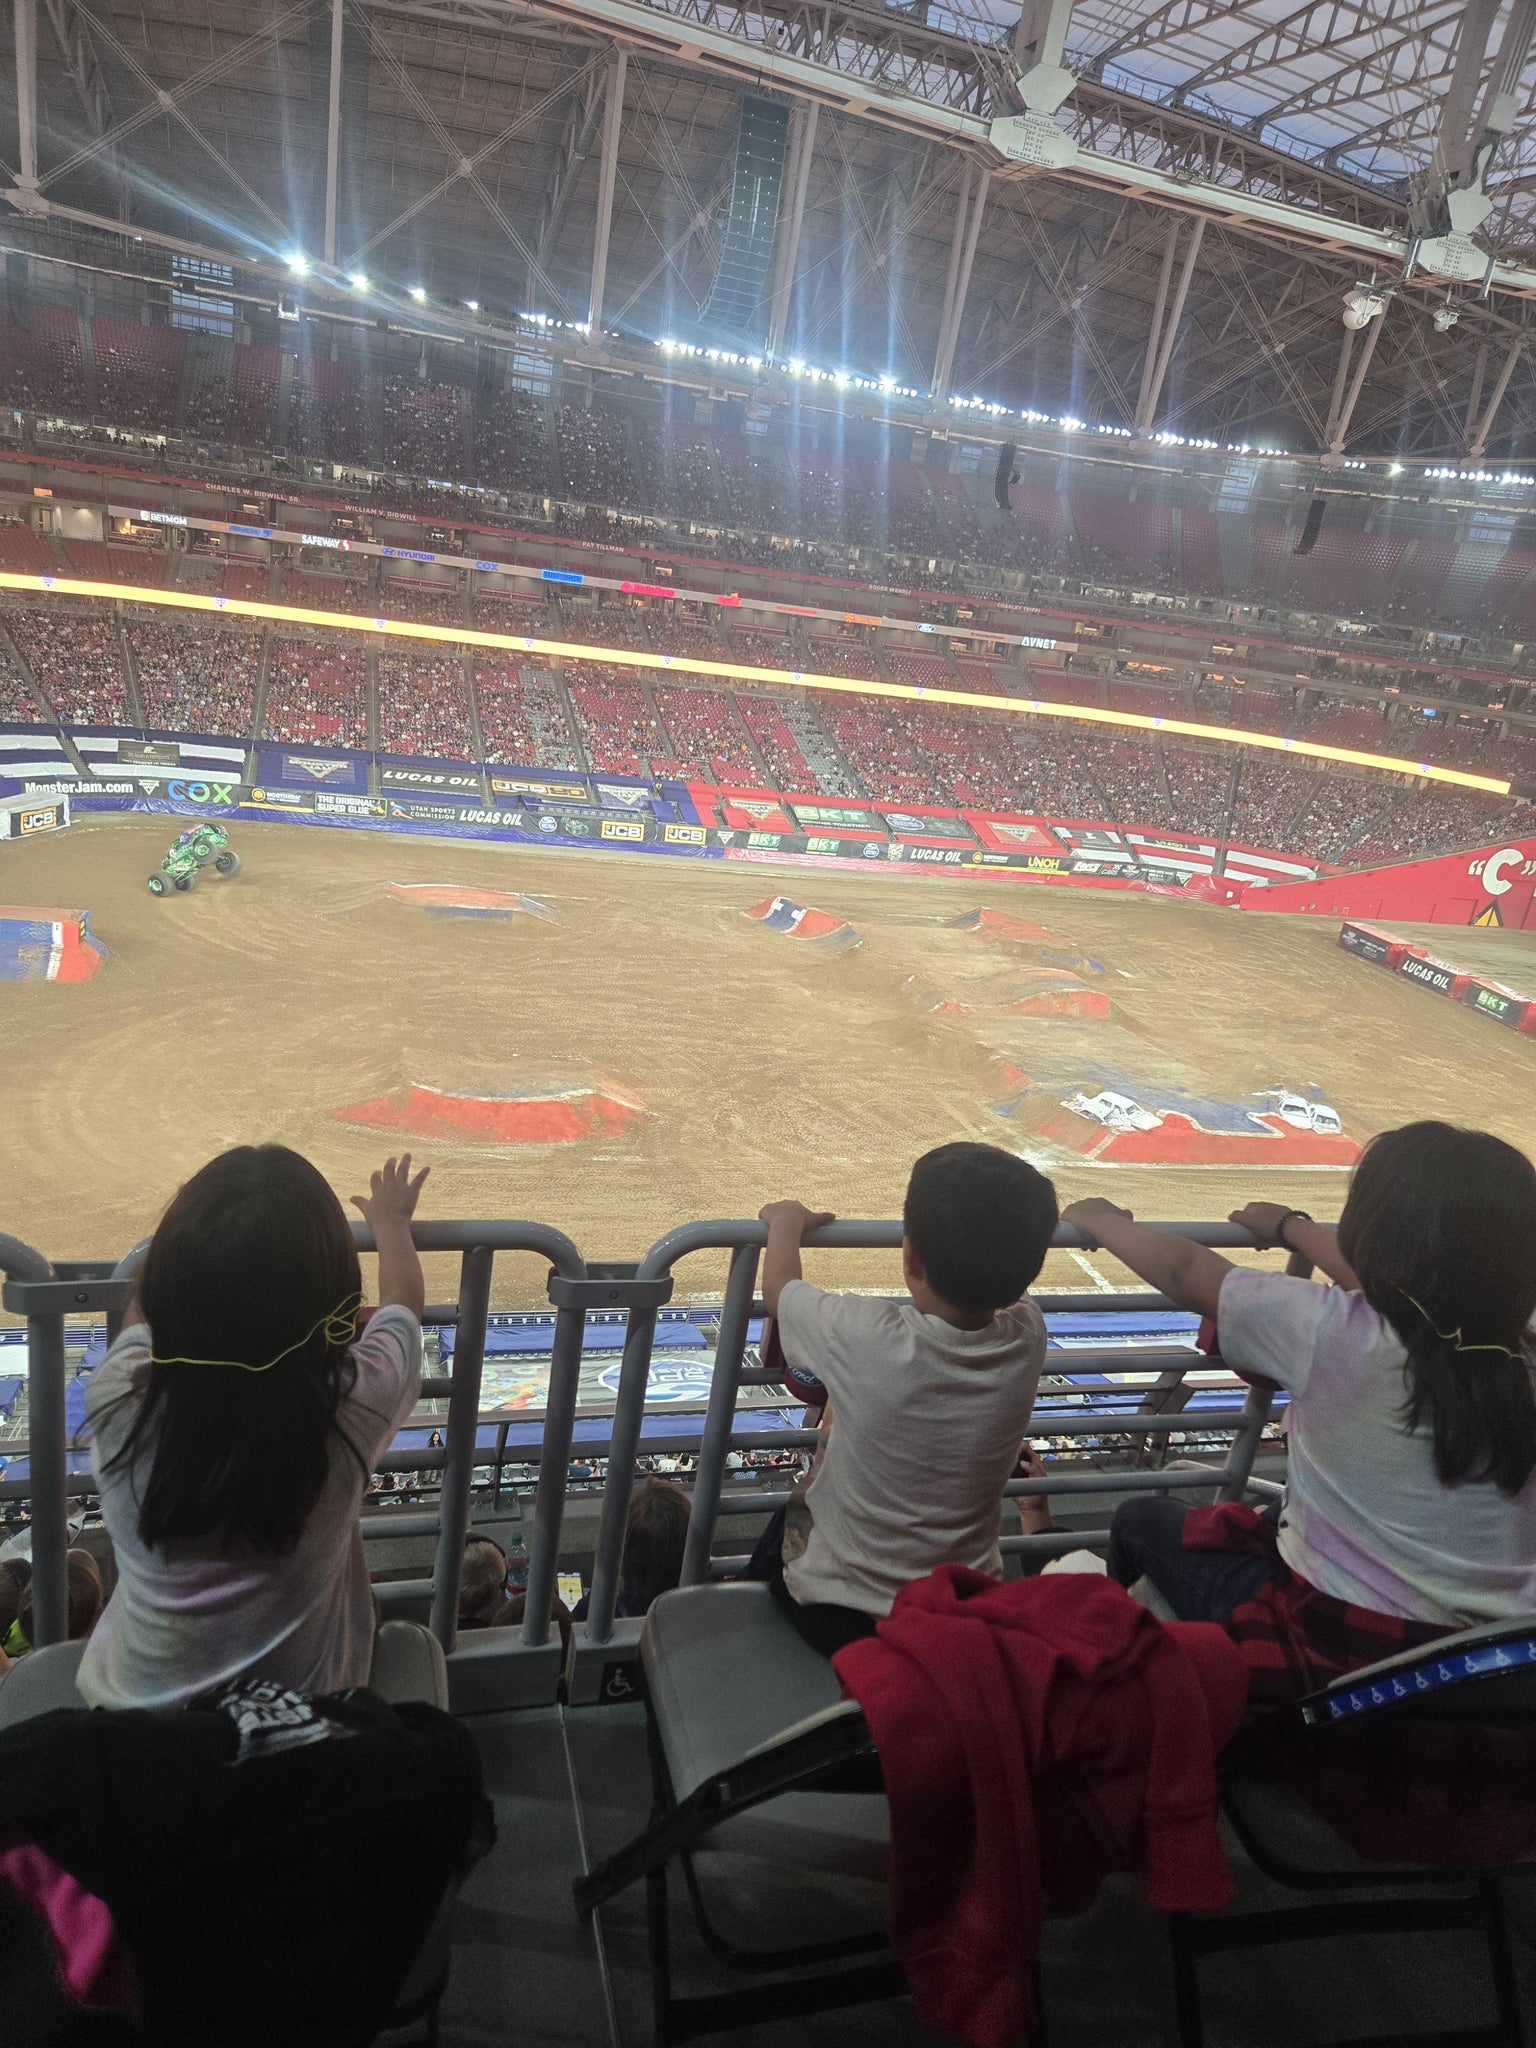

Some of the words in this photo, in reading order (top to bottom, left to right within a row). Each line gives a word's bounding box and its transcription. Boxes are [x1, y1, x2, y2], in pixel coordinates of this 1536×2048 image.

[206, 483, 240, 494] CHARLES
[345, 505, 377, 515] WILLIAM
[387, 511, 417, 521] BIDWILL
[301, 534, 340, 548] SAFEWAY
[596, 544, 624, 553] TILLMAN
[397, 550, 435, 562] HYUNDAI
[476, 561, 498, 571] COX
[1021, 636, 1057, 649] AVNET
[383, 770, 445, 784] LUCAS
[449, 777, 478, 787] OIL
[25, 781, 133, 793] MonsterJam.com
[168, 780, 232, 804] COX
[318, 795, 334, 804] THE
[335, 796, 374, 807] ORIGINAL
[317, 803, 346, 813] SUPER
[348, 805, 370, 814] GLUE
[410, 811, 455, 820] COMMISSION
[795, 806, 864, 822] BKT
[23, 811, 54, 829] JCB
[460, 810, 500, 824] LUCAS
[502, 813, 522, 826] OIL
[605, 825, 641, 837] JCB
[668, 828, 703, 841] JCB
[749, 833, 781, 847] BKT
[806, 838, 840, 852] BKT
[910, 848, 944, 861] LUCAS
[945, 852, 961, 863] OIL
[1028, 856, 1060, 869] UNOH
[1402, 959, 1434, 982] LUCAS
[1433, 973, 1450, 990] OIL
[1477, 990, 1508, 1014] BKT
[789, 1366, 816, 1384] ord
